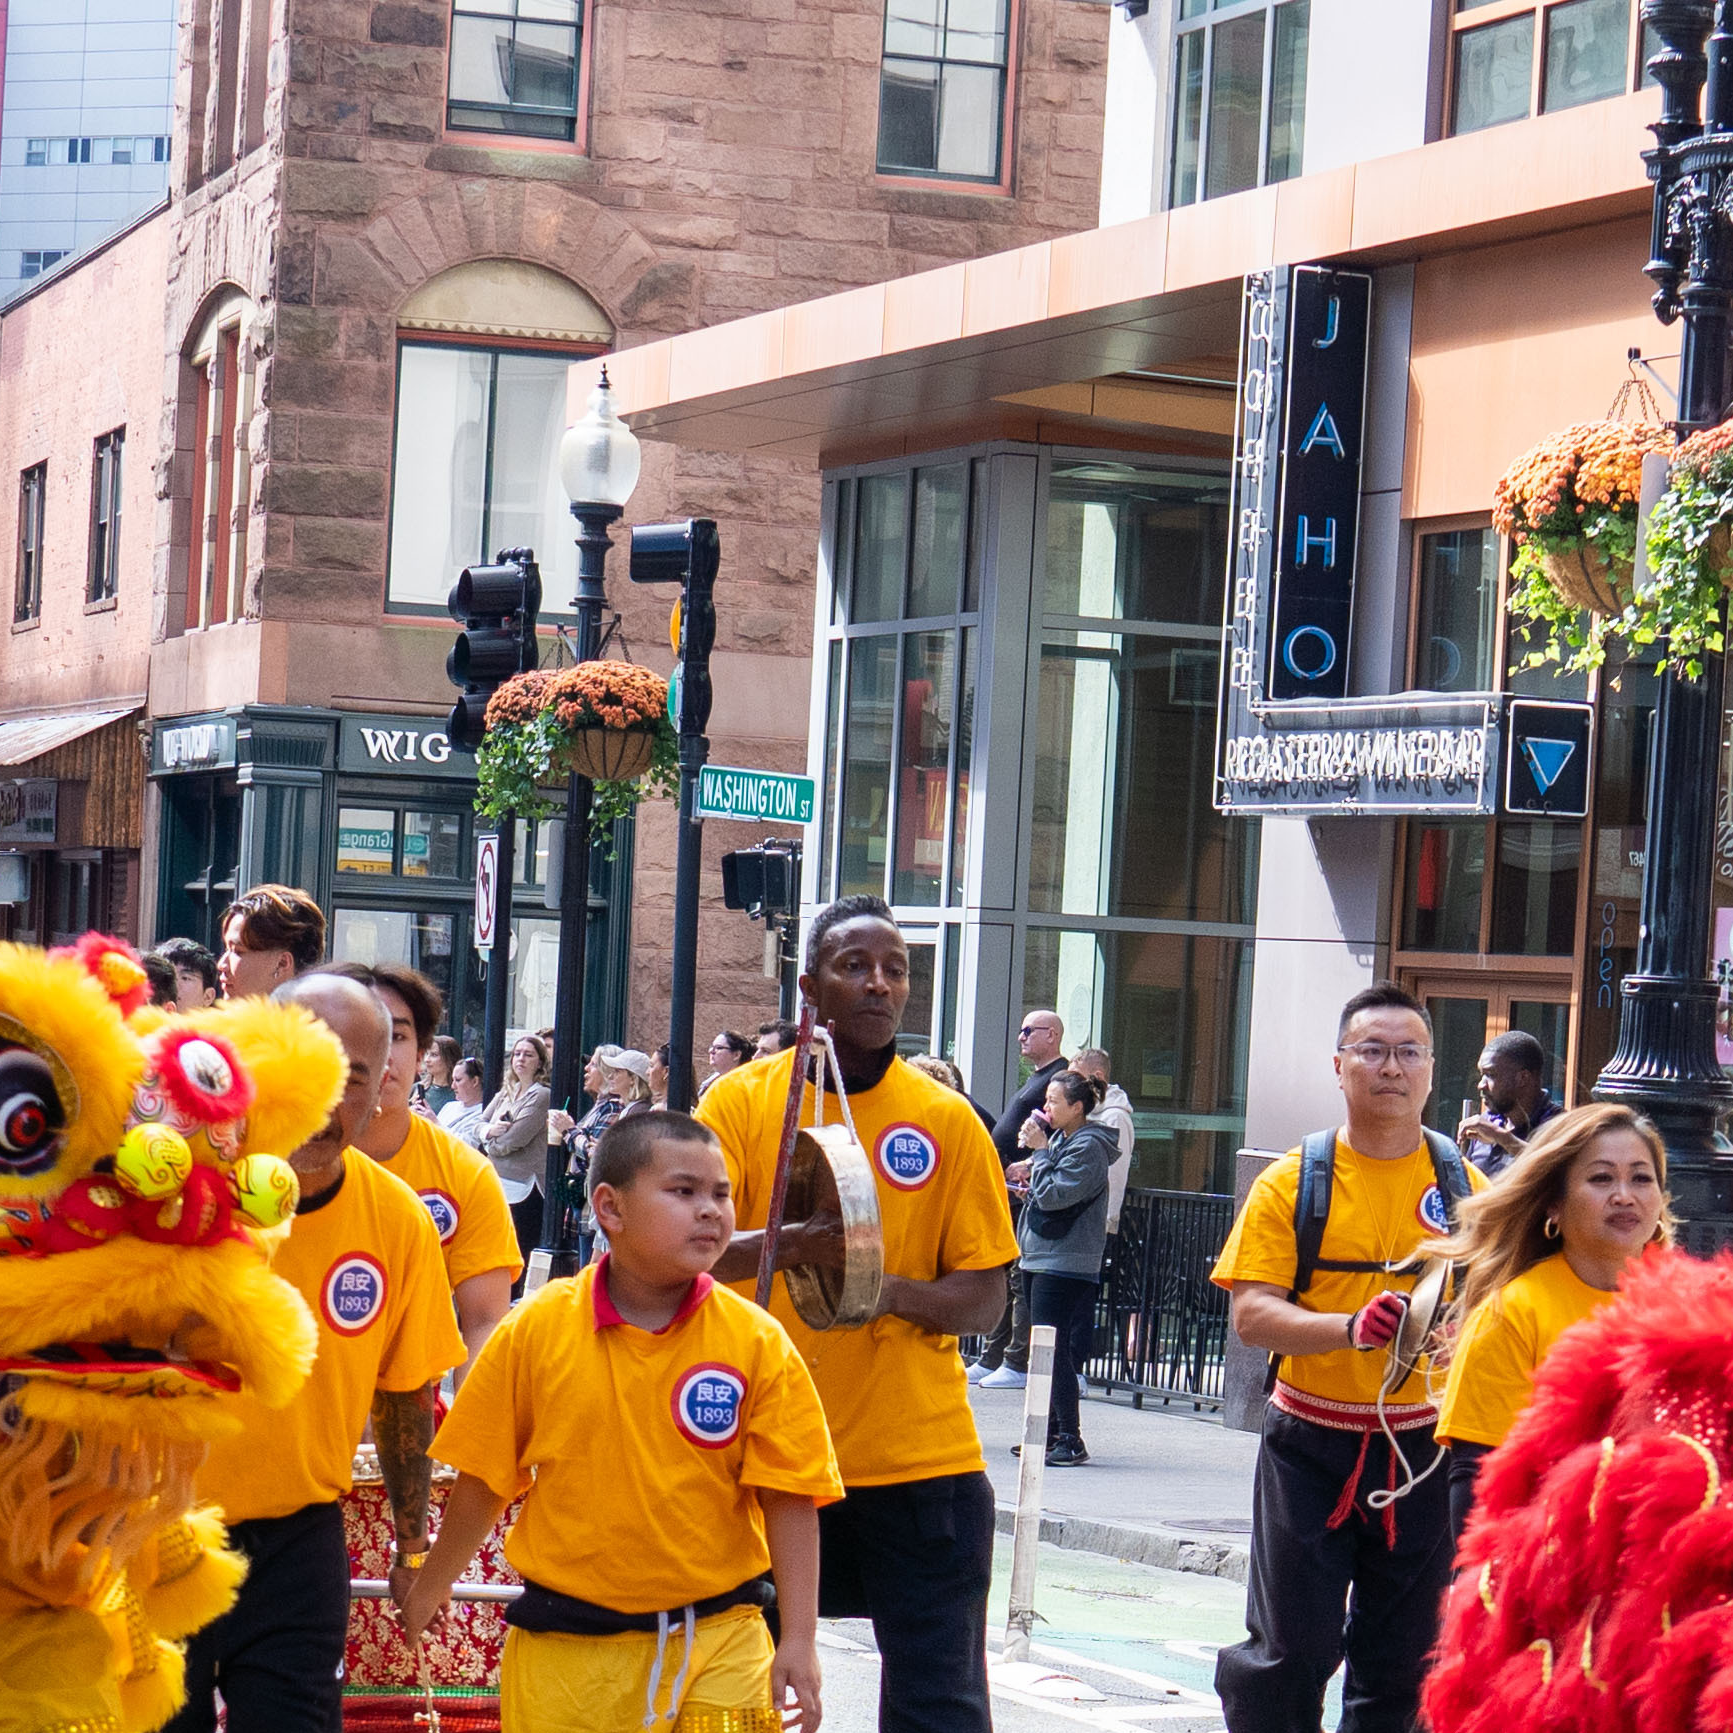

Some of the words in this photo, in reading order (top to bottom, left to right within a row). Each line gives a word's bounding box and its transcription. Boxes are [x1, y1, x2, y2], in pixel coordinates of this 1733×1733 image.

[1283, 294, 1345, 681] JAHO
[703, 772, 797, 816] WASHINGTON
[800, 800, 811, 818] ST
[894, 1138, 921, 1155] 良安
[893, 1157, 924, 1171] 1893
[341, 1272, 370, 1292] 良安
[338, 1296, 370, 1313] 1893
[697, 1382, 732, 1403] 良安
[695, 1406, 733, 1424] 1893
